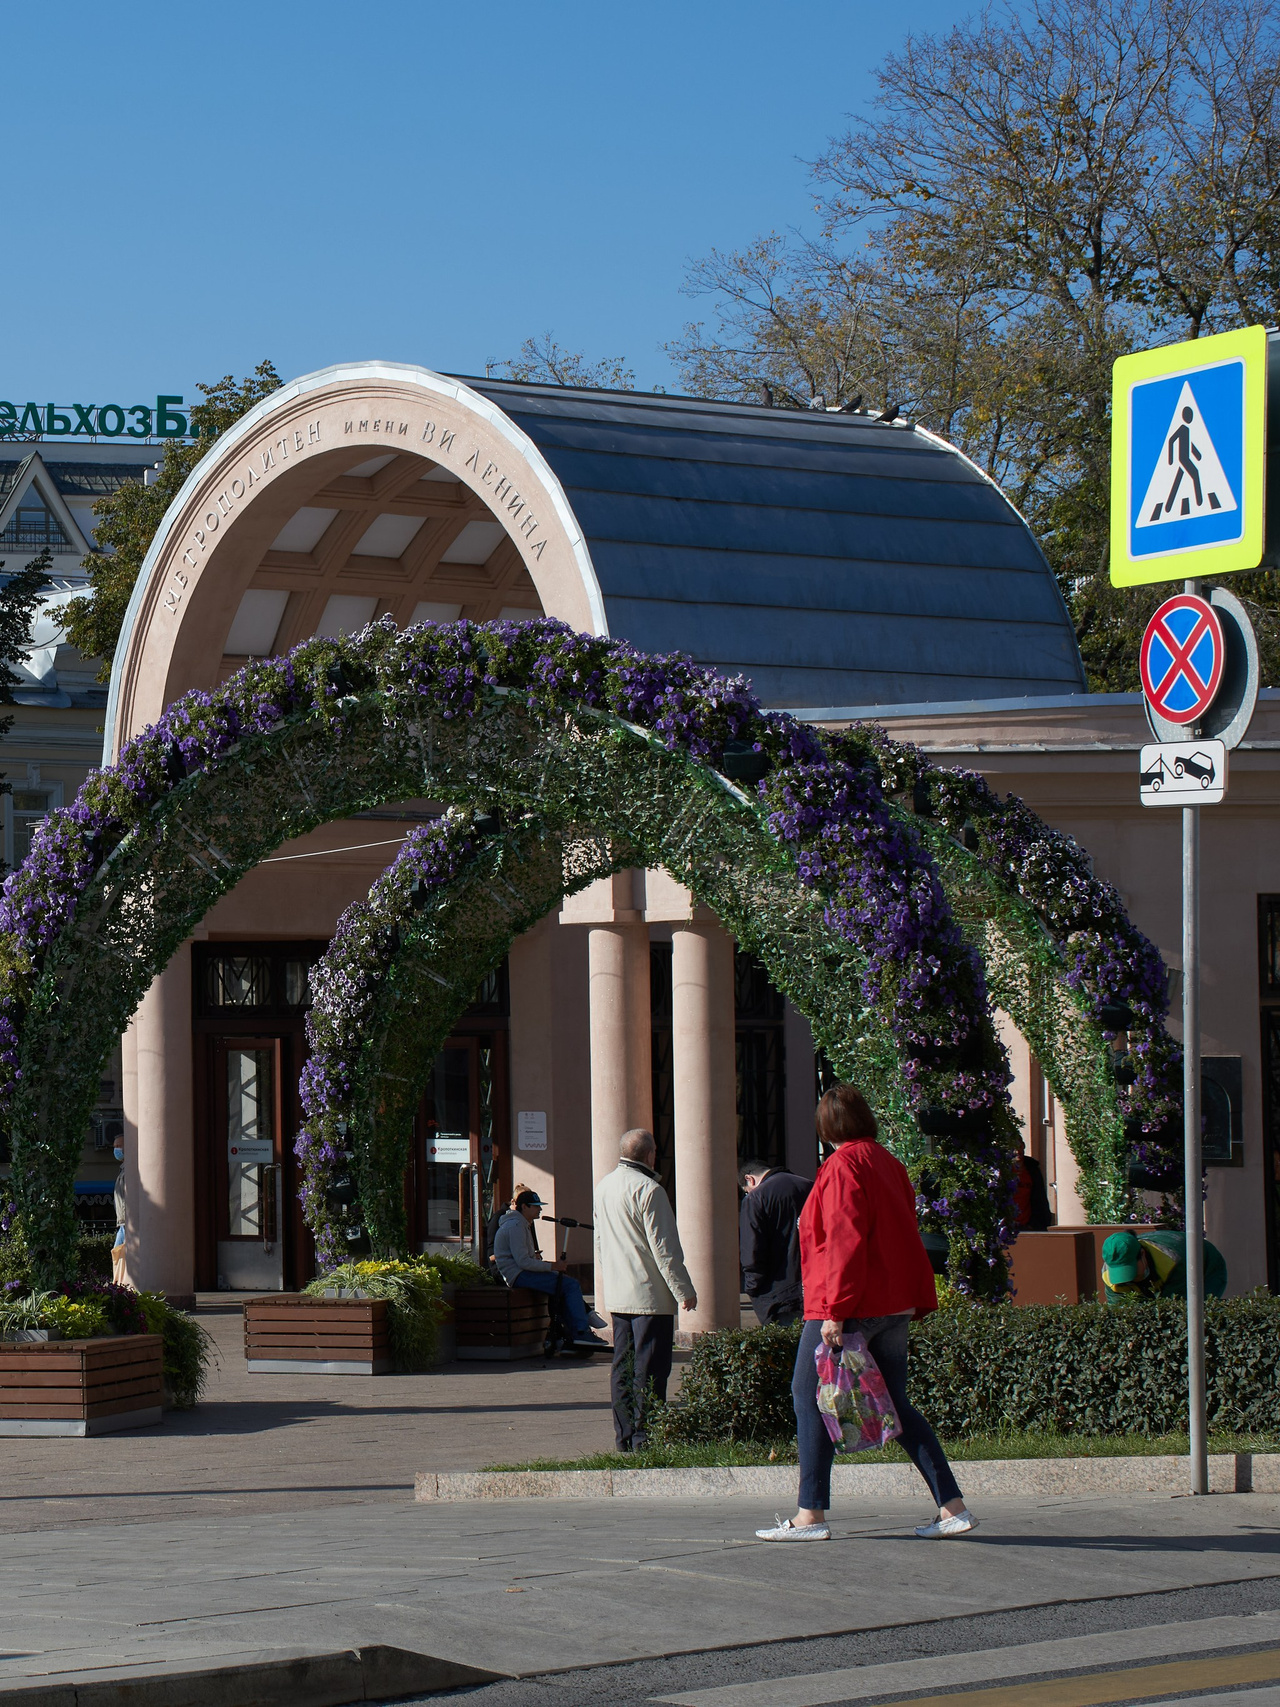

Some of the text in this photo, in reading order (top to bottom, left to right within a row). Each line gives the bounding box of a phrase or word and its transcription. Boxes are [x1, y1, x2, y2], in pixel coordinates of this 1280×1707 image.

[164, 420, 322, 615] МЕТРОПОЛИТЕН
[344, 418, 409, 436] ИМЕНИ
[465, 449, 548, 562] ЛЕНИНА
